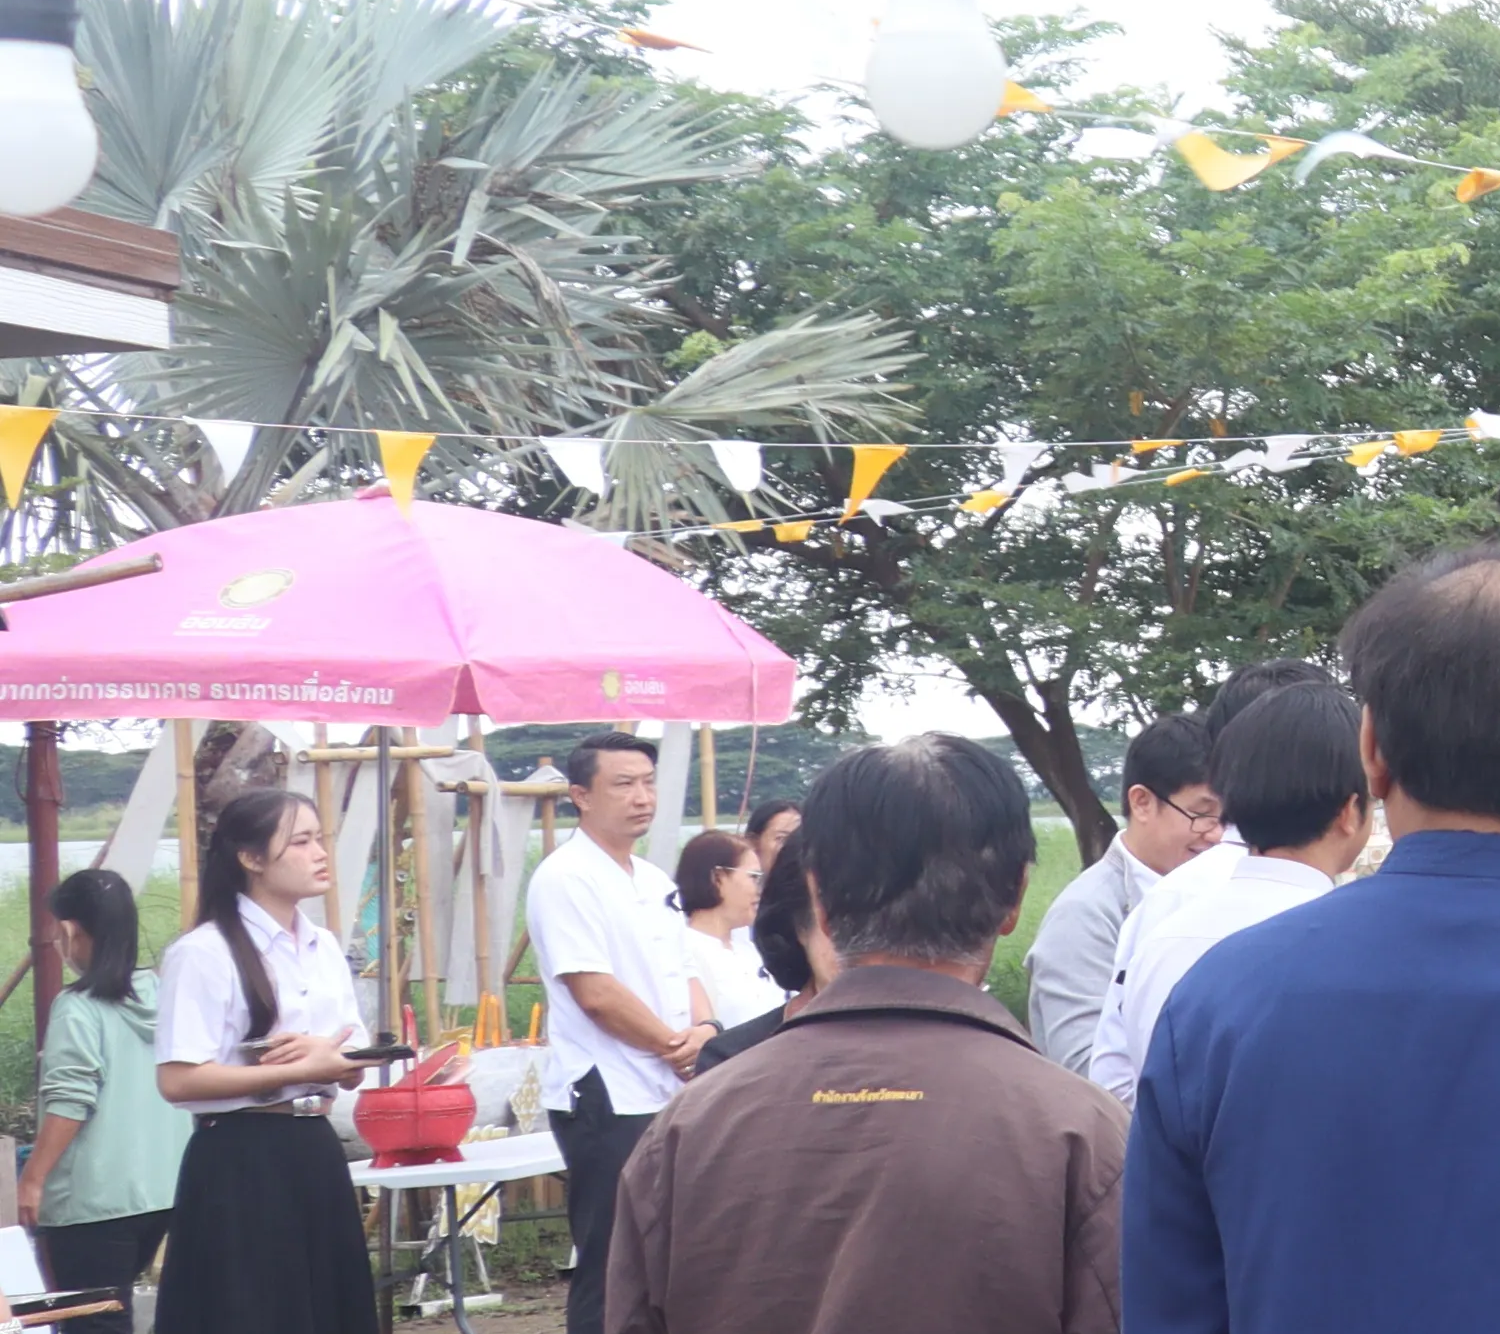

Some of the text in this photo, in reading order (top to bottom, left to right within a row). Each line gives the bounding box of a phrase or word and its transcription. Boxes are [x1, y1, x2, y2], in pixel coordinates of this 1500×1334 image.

[210, 670, 396, 705] ธนาคารเพื่อสังคม
